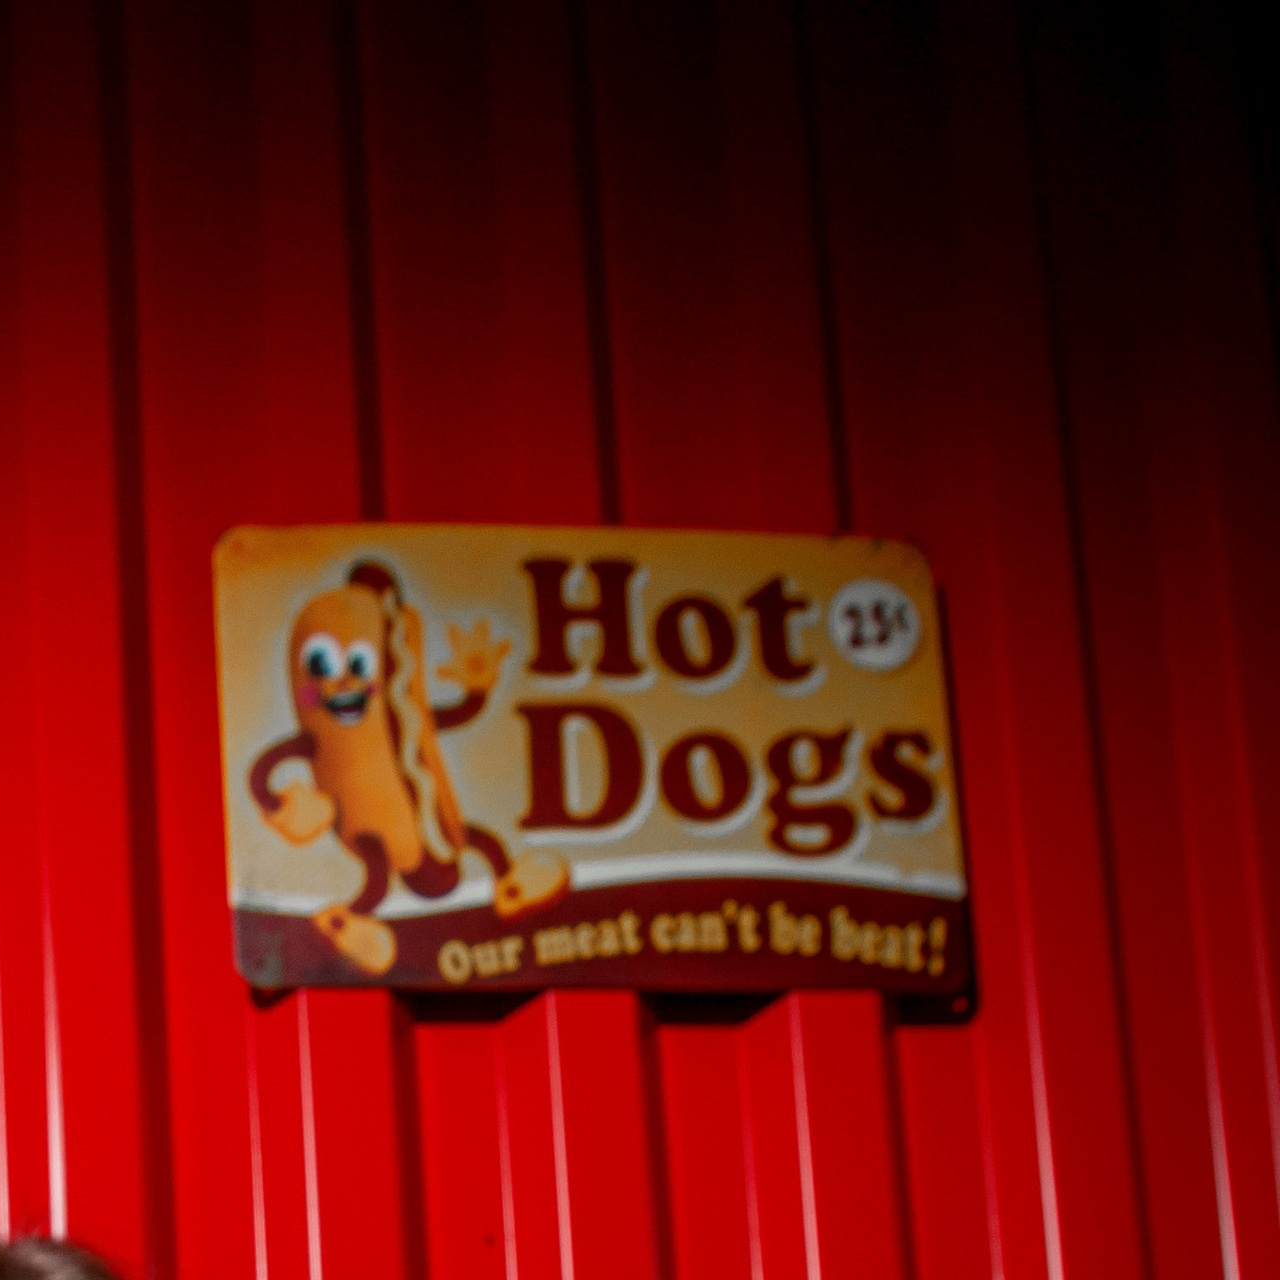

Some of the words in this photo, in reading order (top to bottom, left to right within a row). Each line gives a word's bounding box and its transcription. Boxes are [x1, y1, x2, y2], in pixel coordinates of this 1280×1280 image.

[520, 556, 819, 684] Hot
[517, 702, 941, 859] Dogs
[436, 935, 523, 984] Our
[533, 910, 643, 966] meat
[650, 899, 761, 953] can't
[767, 901, 822, 957] be
[829, 904, 948, 978] beat!
